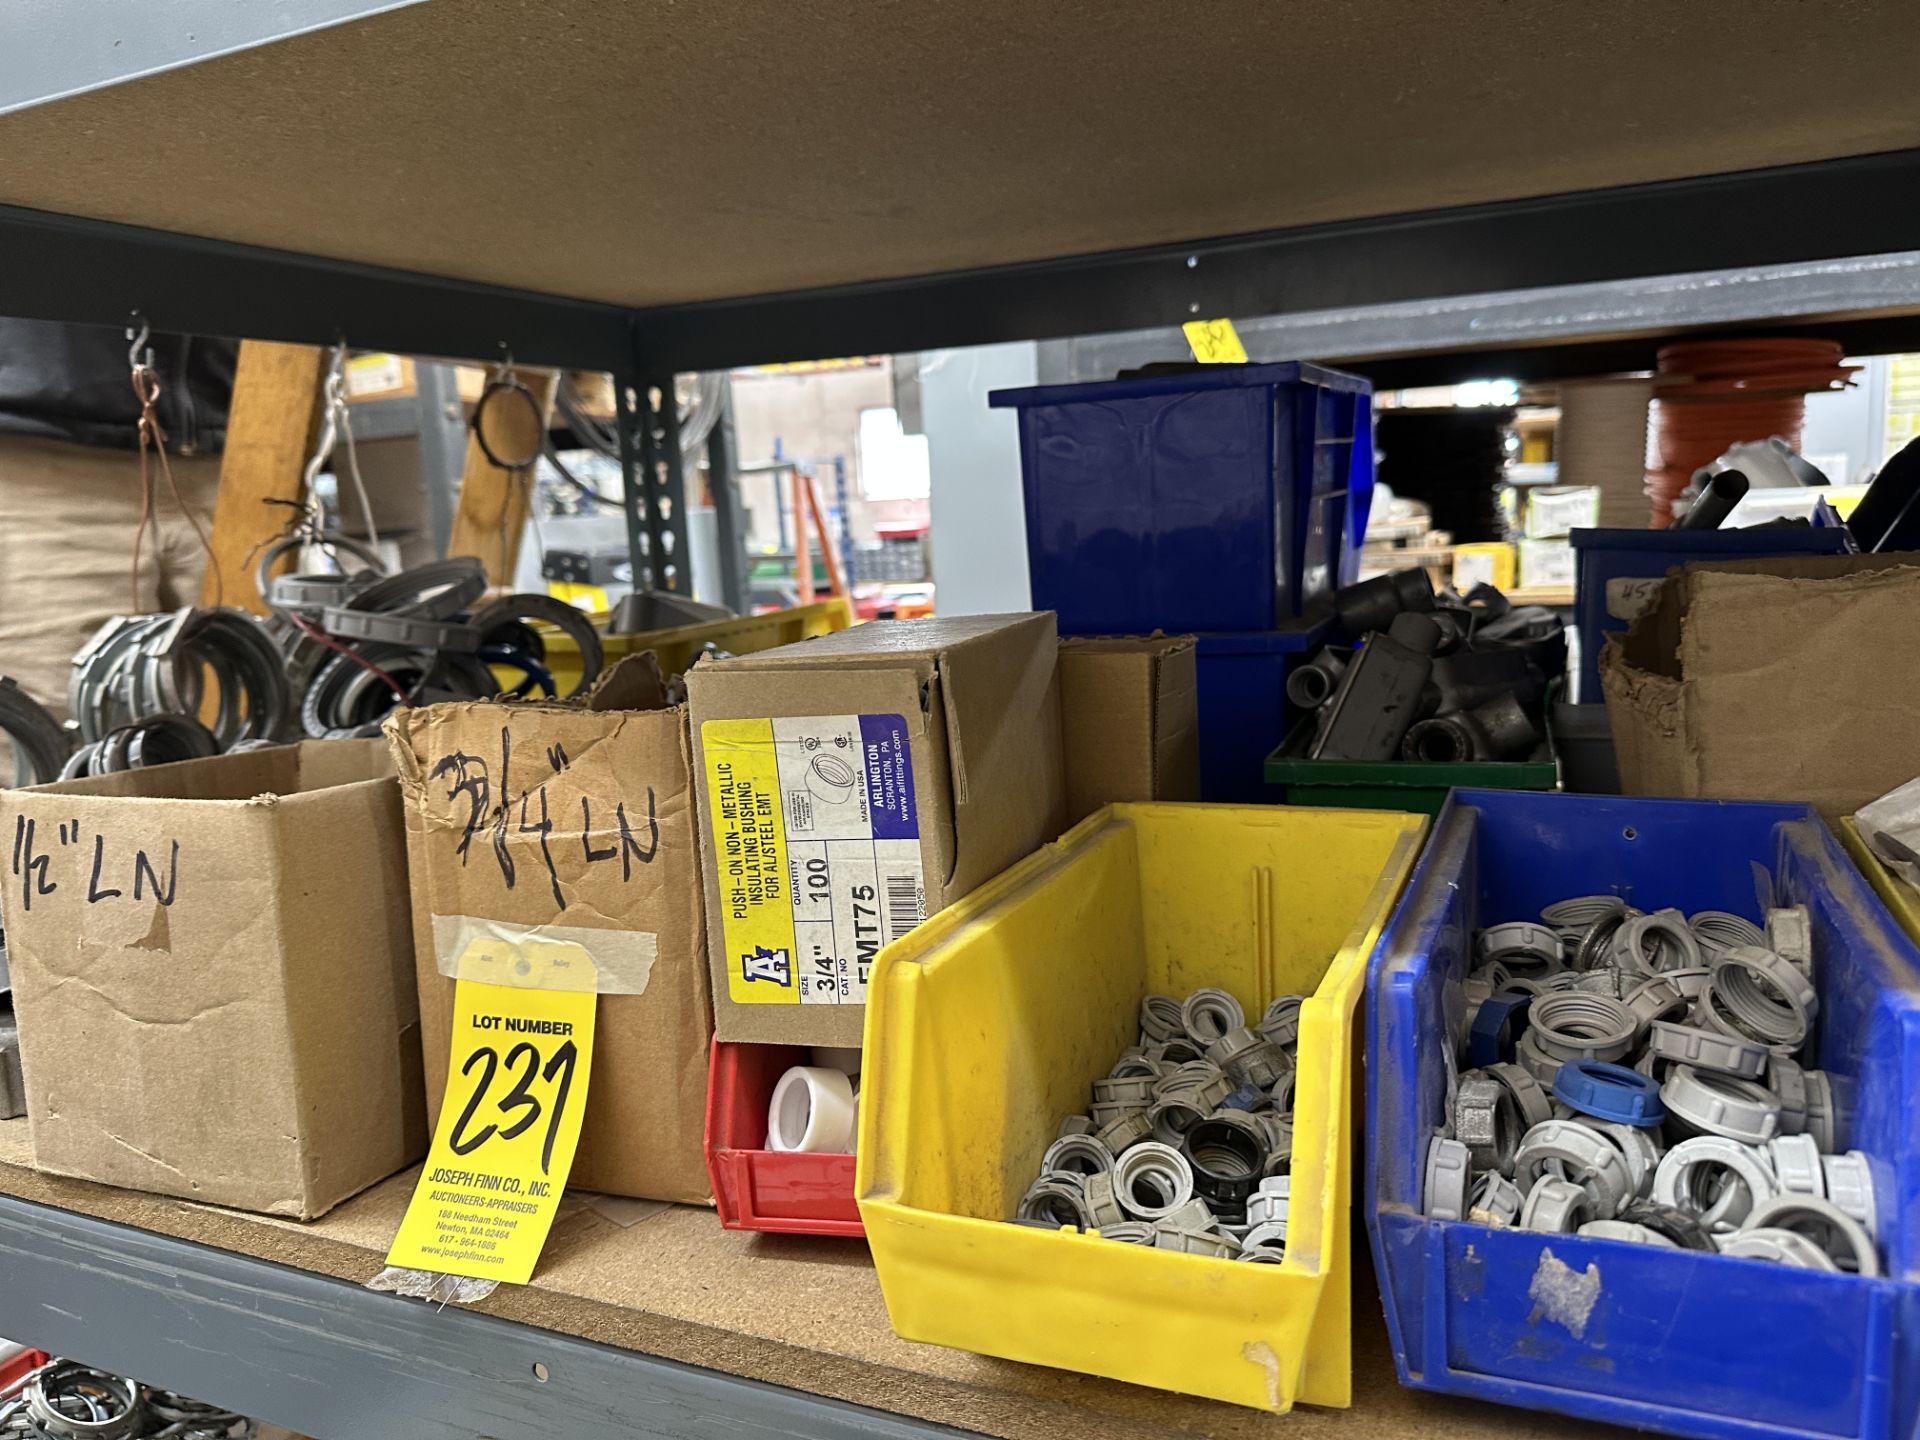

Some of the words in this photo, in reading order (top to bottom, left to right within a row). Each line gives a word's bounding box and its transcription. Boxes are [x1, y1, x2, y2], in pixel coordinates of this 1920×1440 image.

[881, 741, 890, 753] PA
[857, 770, 865, 787] USA
[868, 744, 884, 808] ARLINGTON
[892, 730, 909, 821] www.aifittings.com
[756, 792, 772, 816] EMT
[859, 789, 866, 797] IN
[737, 782, 756, 833] BUSHING
[860, 799, 868, 822] MADE
[581, 785, 659, 883] LN
[759, 820, 778, 874] AL/STEEL
[88, 834, 180, 906] LN
[743, 838, 764, 906] INSULATING
[807, 858, 829, 903] 100
[765, 877, 780, 899] FOR
[790, 860, 801, 906] QUANTITY
[917, 888, 928, 925] 122050
[813, 946, 835, 991] 3/4"
[839, 959, 847, 972] NO
[801, 975, 809, 996] SIZE
[840, 973, 849, 996] CAT.
[472, 1014, 502, 1029] LOT
[505, 1017, 573, 1036] NUMBER
[450, 1039, 578, 1176] 237
[429, 1168, 474, 1187] JOSEPH
[474, 1174, 503, 1191] FINN
[503, 1177, 525, 1197] CO.,
[528, 1181, 551, 1198] INC.
[429, 1190, 539, 1214] AUCTIONEERS-APPRAISERS
[436, 1222, 468, 1235] Newton,
[470, 1226, 484, 1236] MA
[453, 1212, 492, 1225] Needham
[492, 1216, 518, 1229] Street
[438, 1234, 455, 1244] 617
[421, 1245, 505, 1265] www.josephfinn.com
